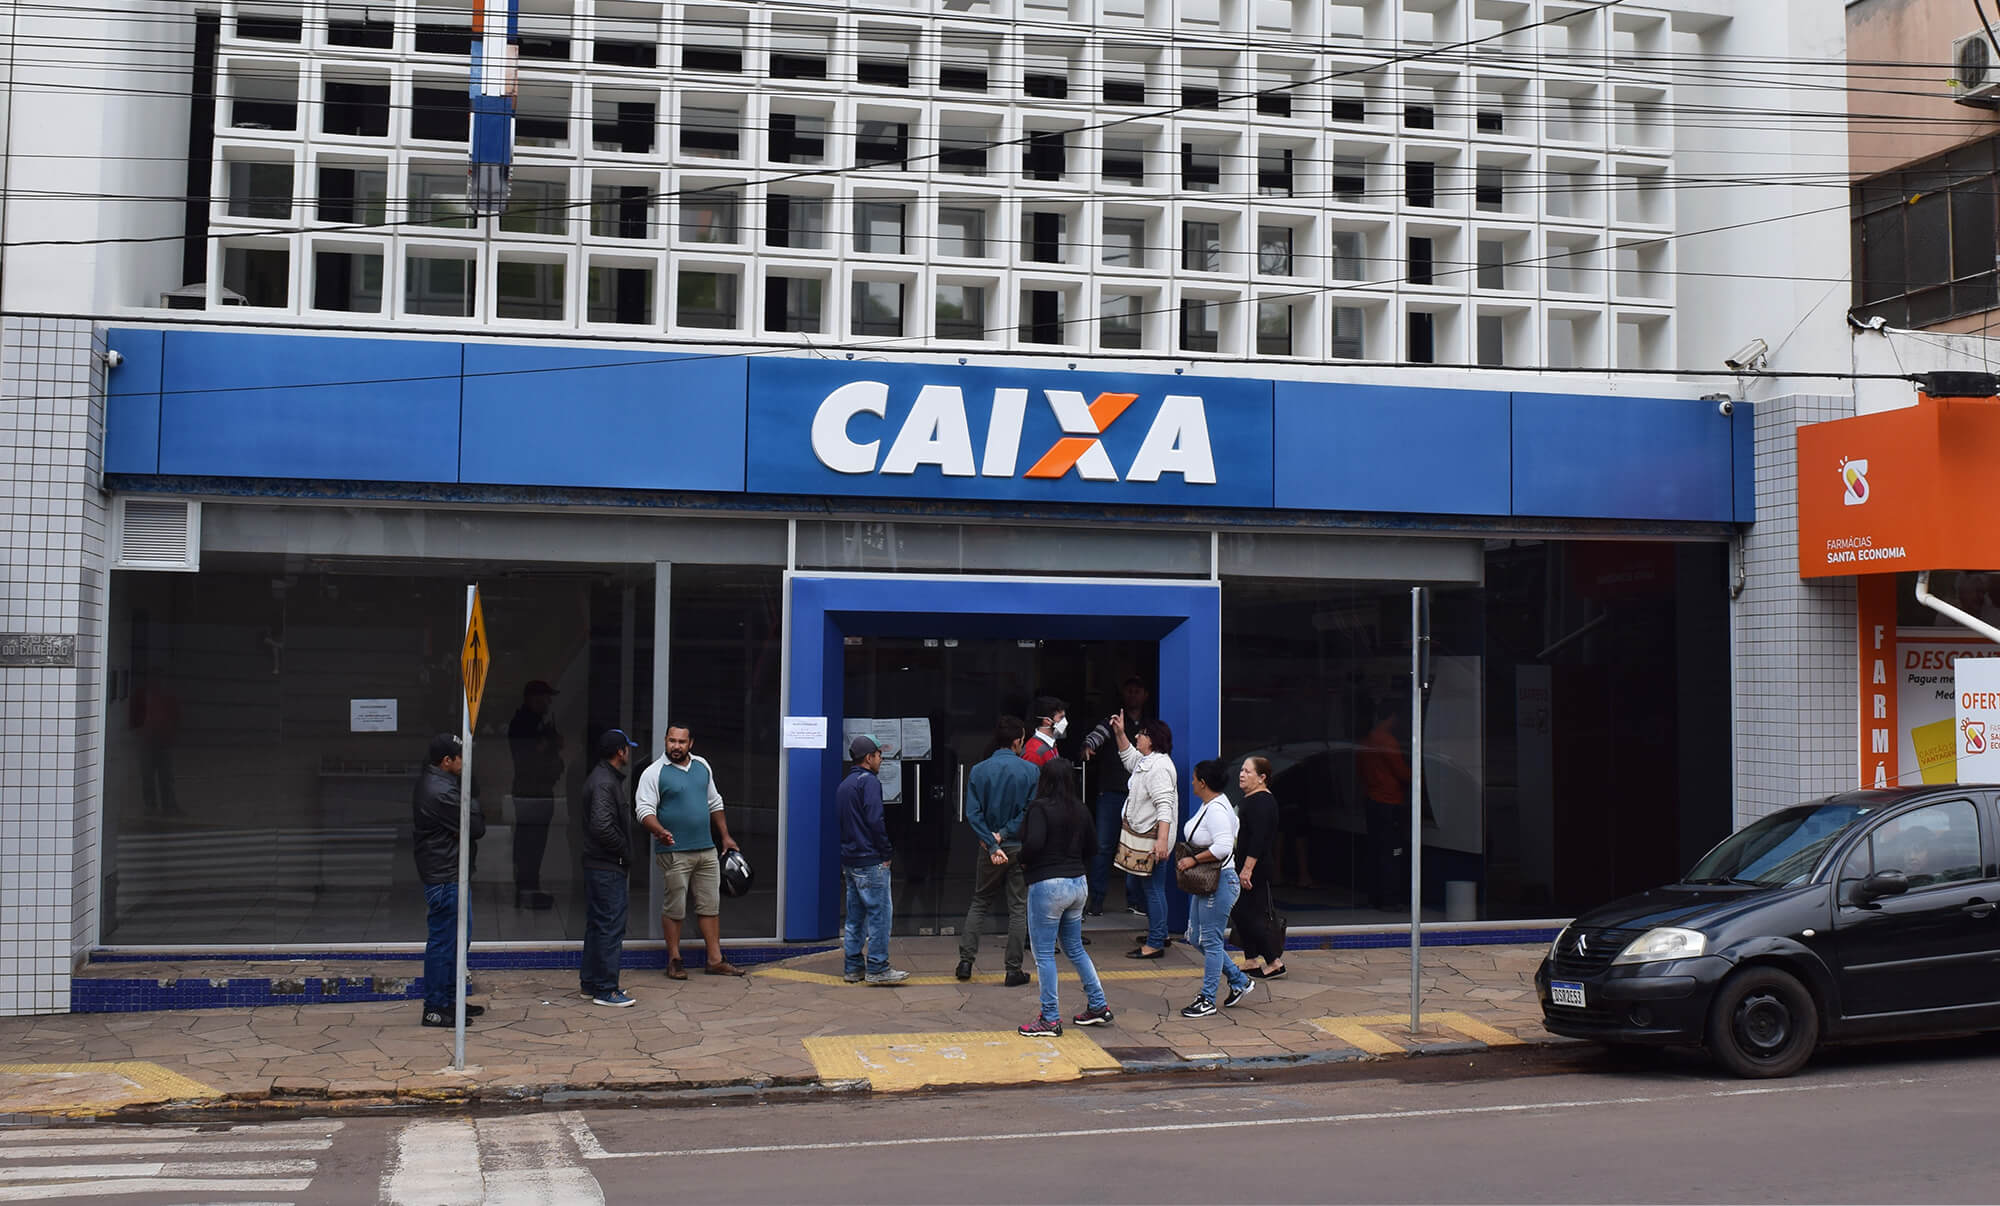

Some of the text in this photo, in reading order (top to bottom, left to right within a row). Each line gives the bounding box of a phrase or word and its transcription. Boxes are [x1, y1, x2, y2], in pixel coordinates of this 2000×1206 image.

[811, 380, 1217, 484] CAIXA
[1826, 536, 1872, 550] FARMÁCIAS
[1827, 547, 1906, 563] SANTA ECONOMIA
[2, 646, 16, 656] DO
[1908, 674, 1938, 686] Pague
